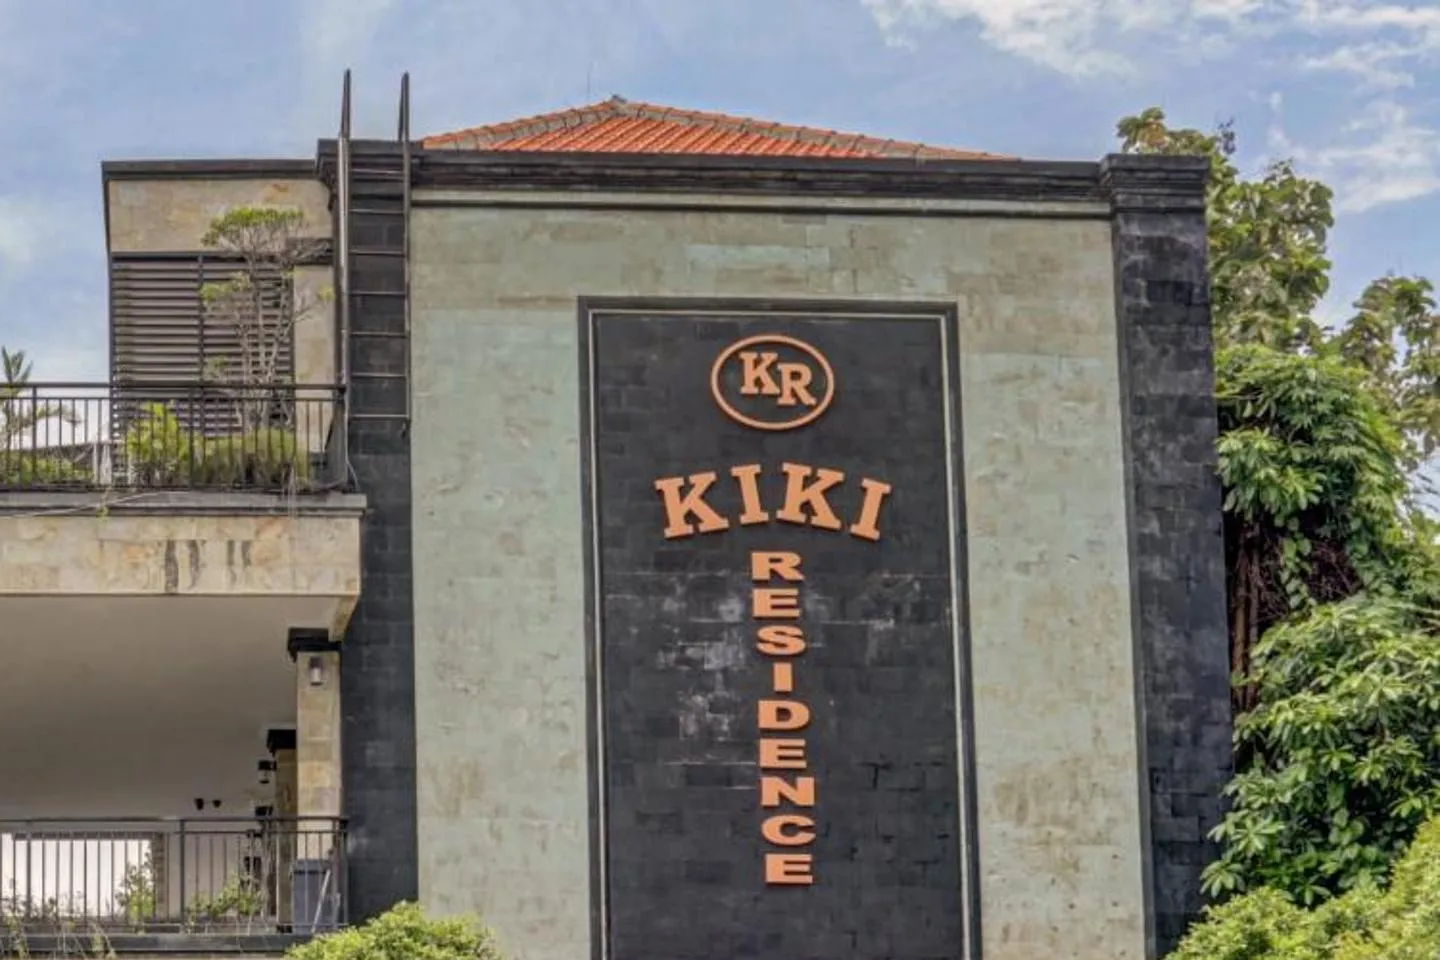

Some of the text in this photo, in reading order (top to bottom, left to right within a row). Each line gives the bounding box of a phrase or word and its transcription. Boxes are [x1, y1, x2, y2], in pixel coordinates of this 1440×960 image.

[739, 351, 817, 406] KR
[654, 462, 892, 541] KIKI
[750, 551, 817, 885] RESIDENCE
